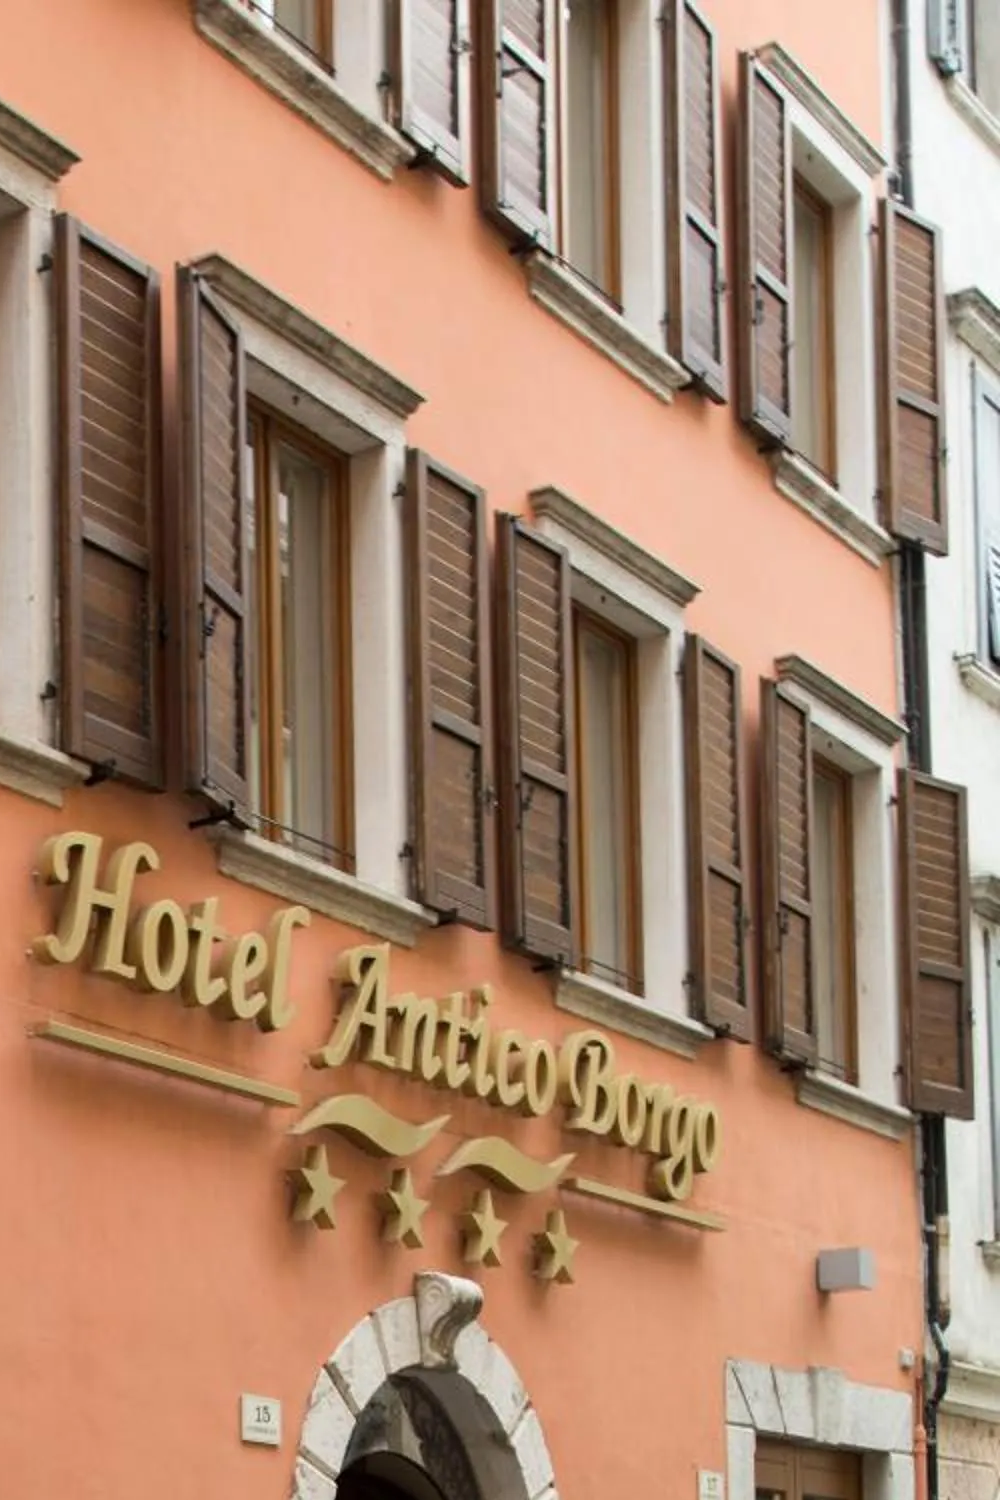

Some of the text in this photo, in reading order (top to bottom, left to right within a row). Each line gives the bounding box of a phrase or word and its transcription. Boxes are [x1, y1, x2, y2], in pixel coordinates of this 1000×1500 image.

[36, 831, 722, 1200] Hotel Antico Borgo
